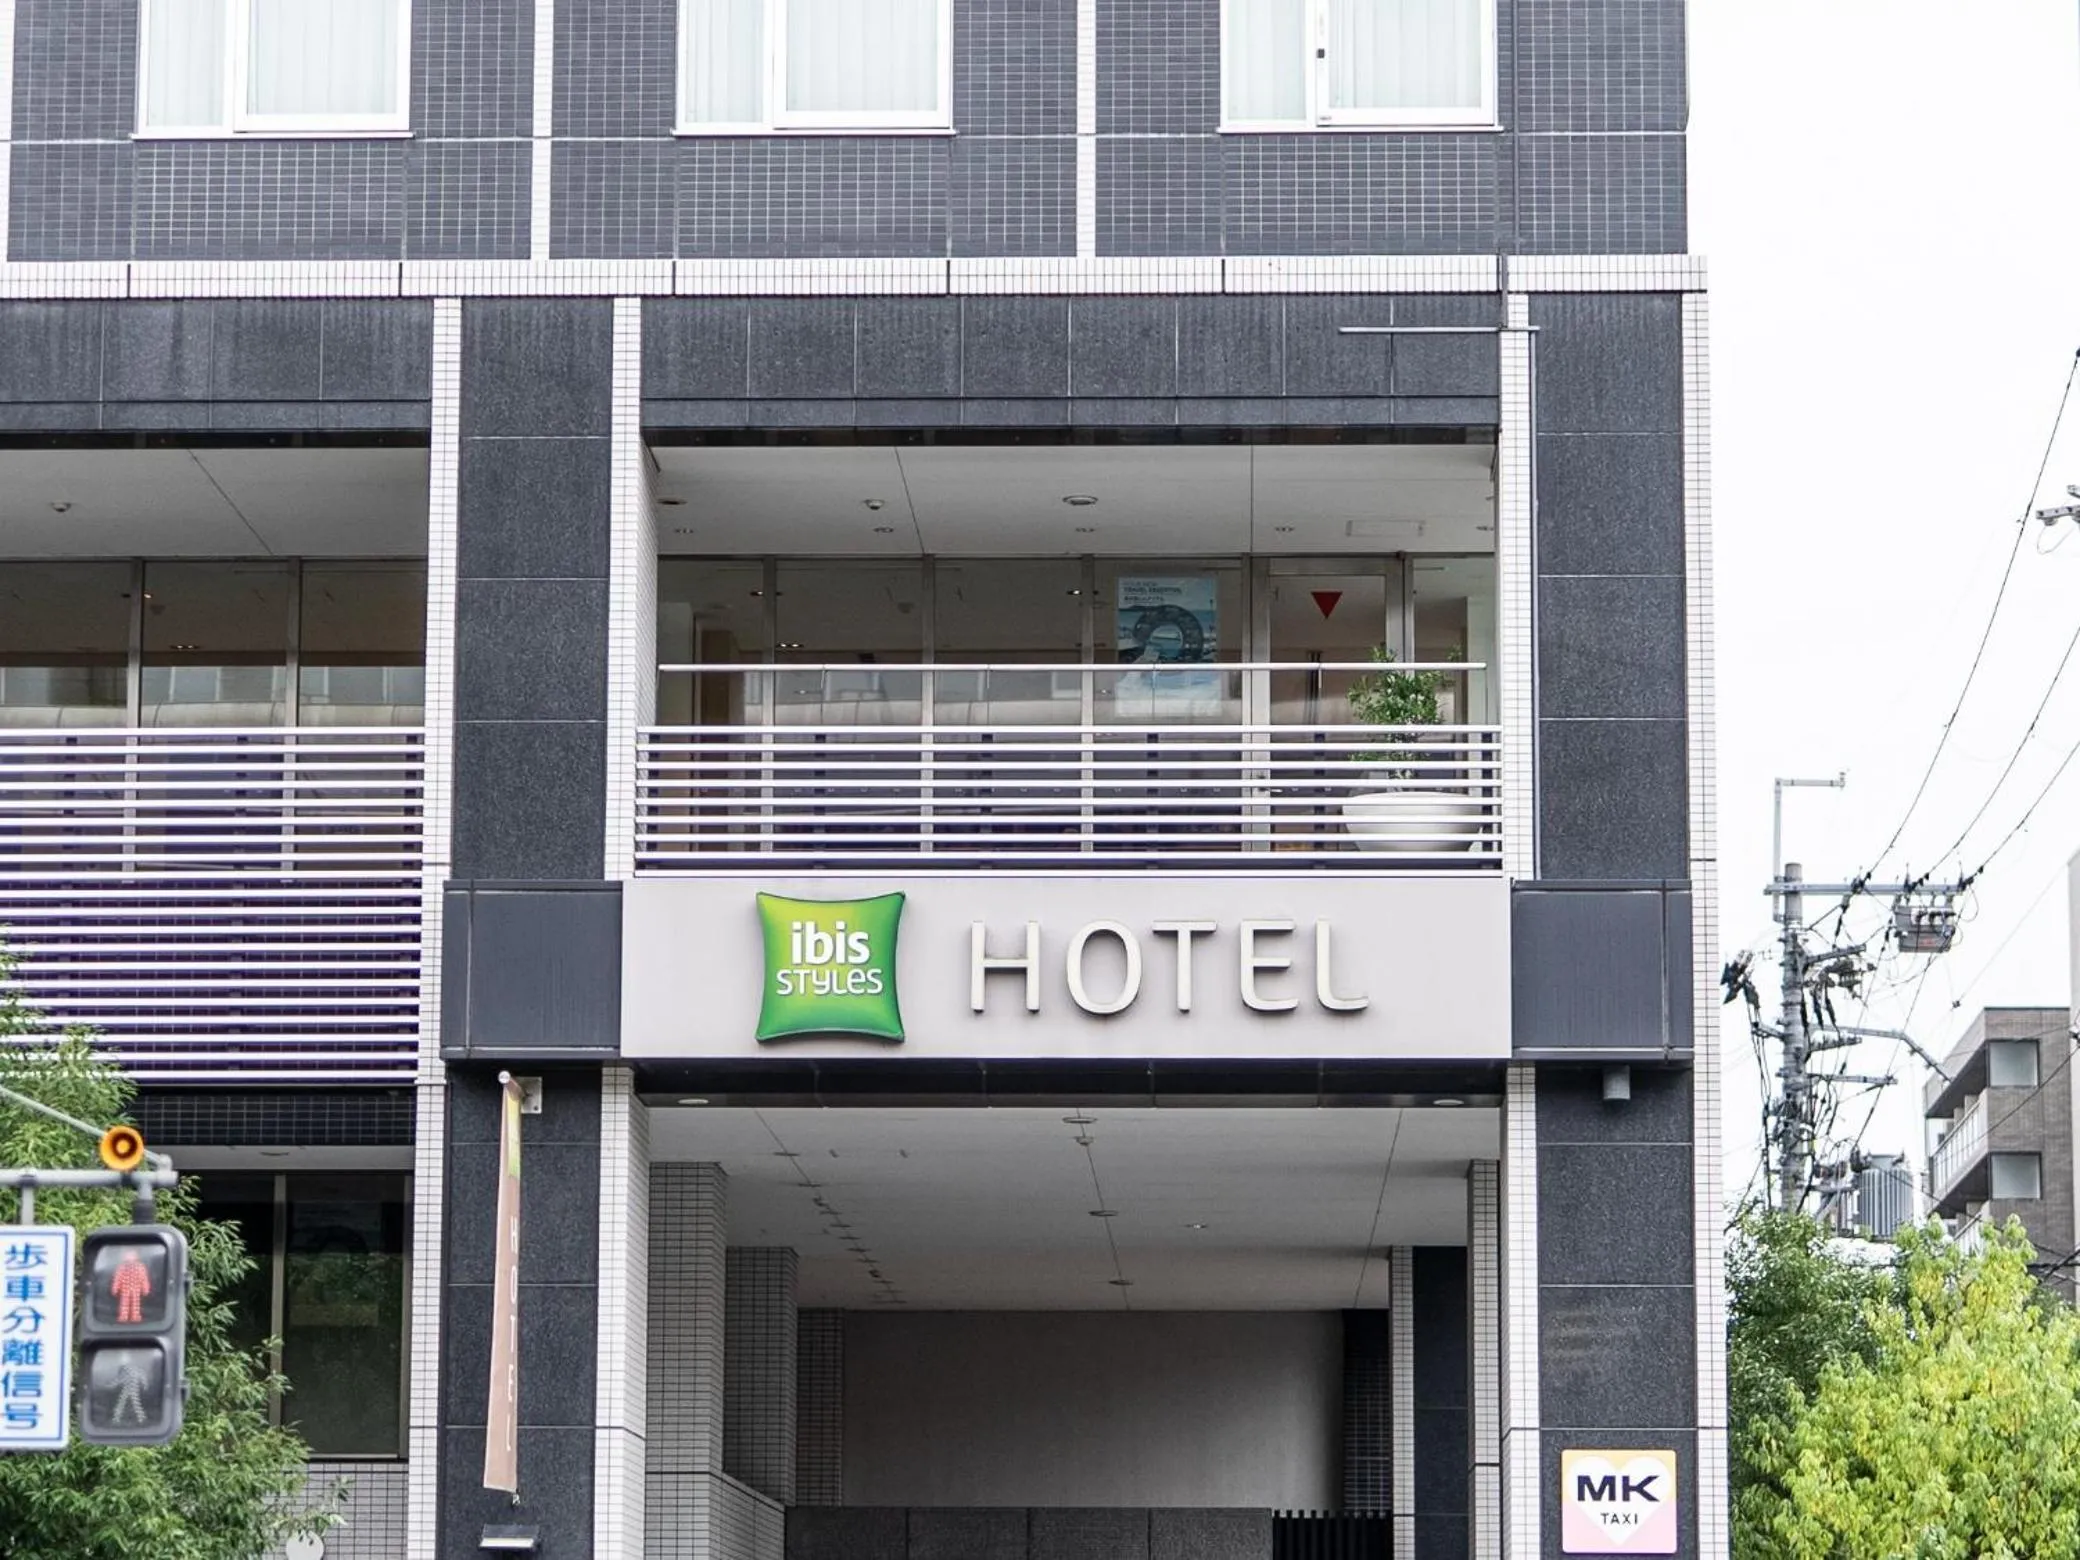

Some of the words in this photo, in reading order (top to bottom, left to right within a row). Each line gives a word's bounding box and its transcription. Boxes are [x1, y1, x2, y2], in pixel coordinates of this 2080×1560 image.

[790, 921, 870, 965] ibis
[969, 919, 1369, 1015] HOTEL
[0, 1242, 48, 1430] 歩車分離信号
[506, 1216, 518, 1452] HOTEL
[1577, 1475, 1660, 1502] MK
[1600, 1512, 1639, 1525] TAXI
